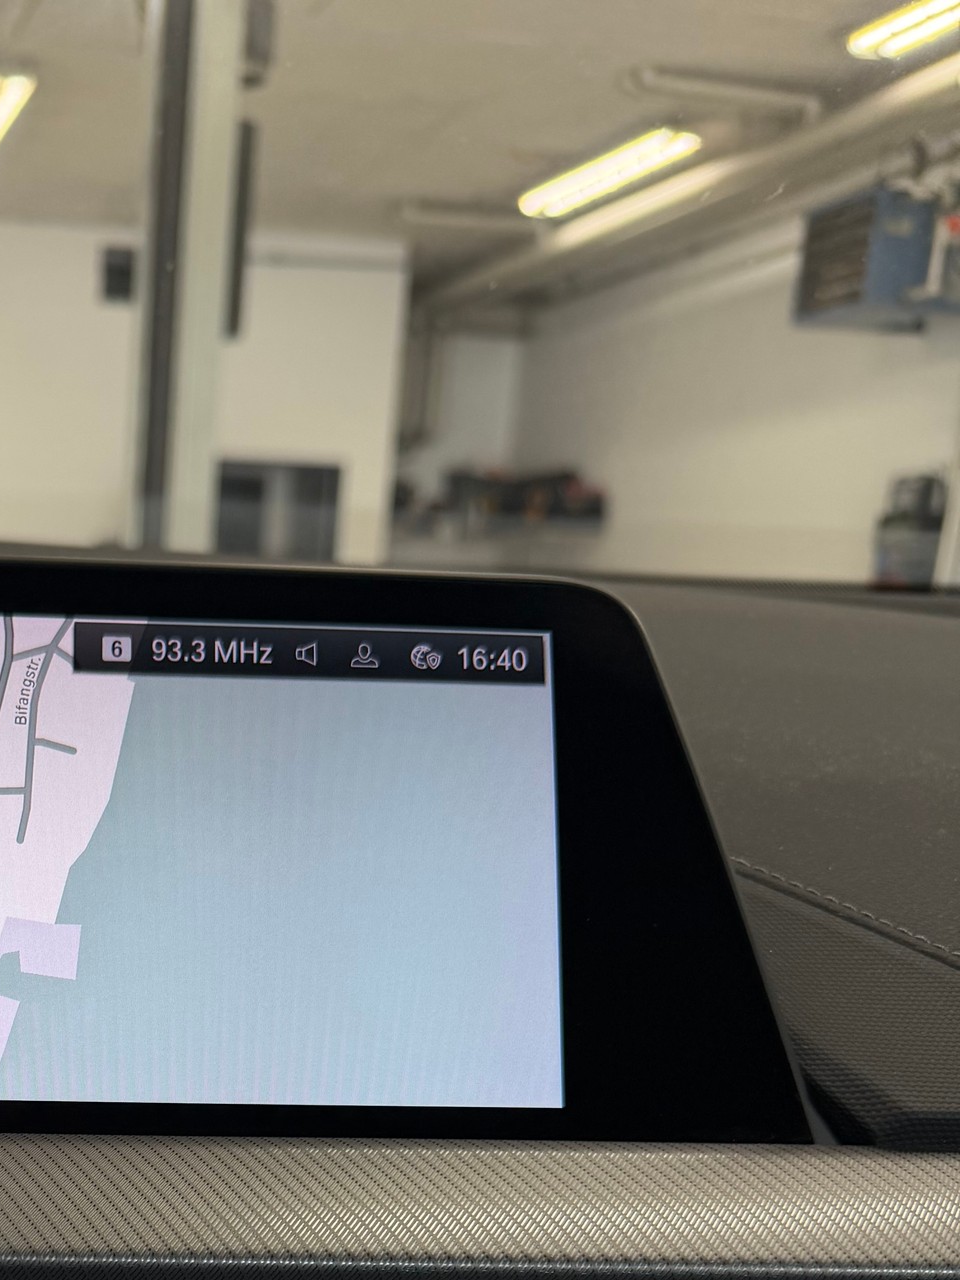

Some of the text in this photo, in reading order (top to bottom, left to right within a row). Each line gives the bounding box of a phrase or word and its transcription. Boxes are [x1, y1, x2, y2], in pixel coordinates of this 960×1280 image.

[111, 638, 273, 664] 6 93.3 MHz
[457, 646, 528, 672] 16:40
[14, 657, 42, 726] Bifangstr.
